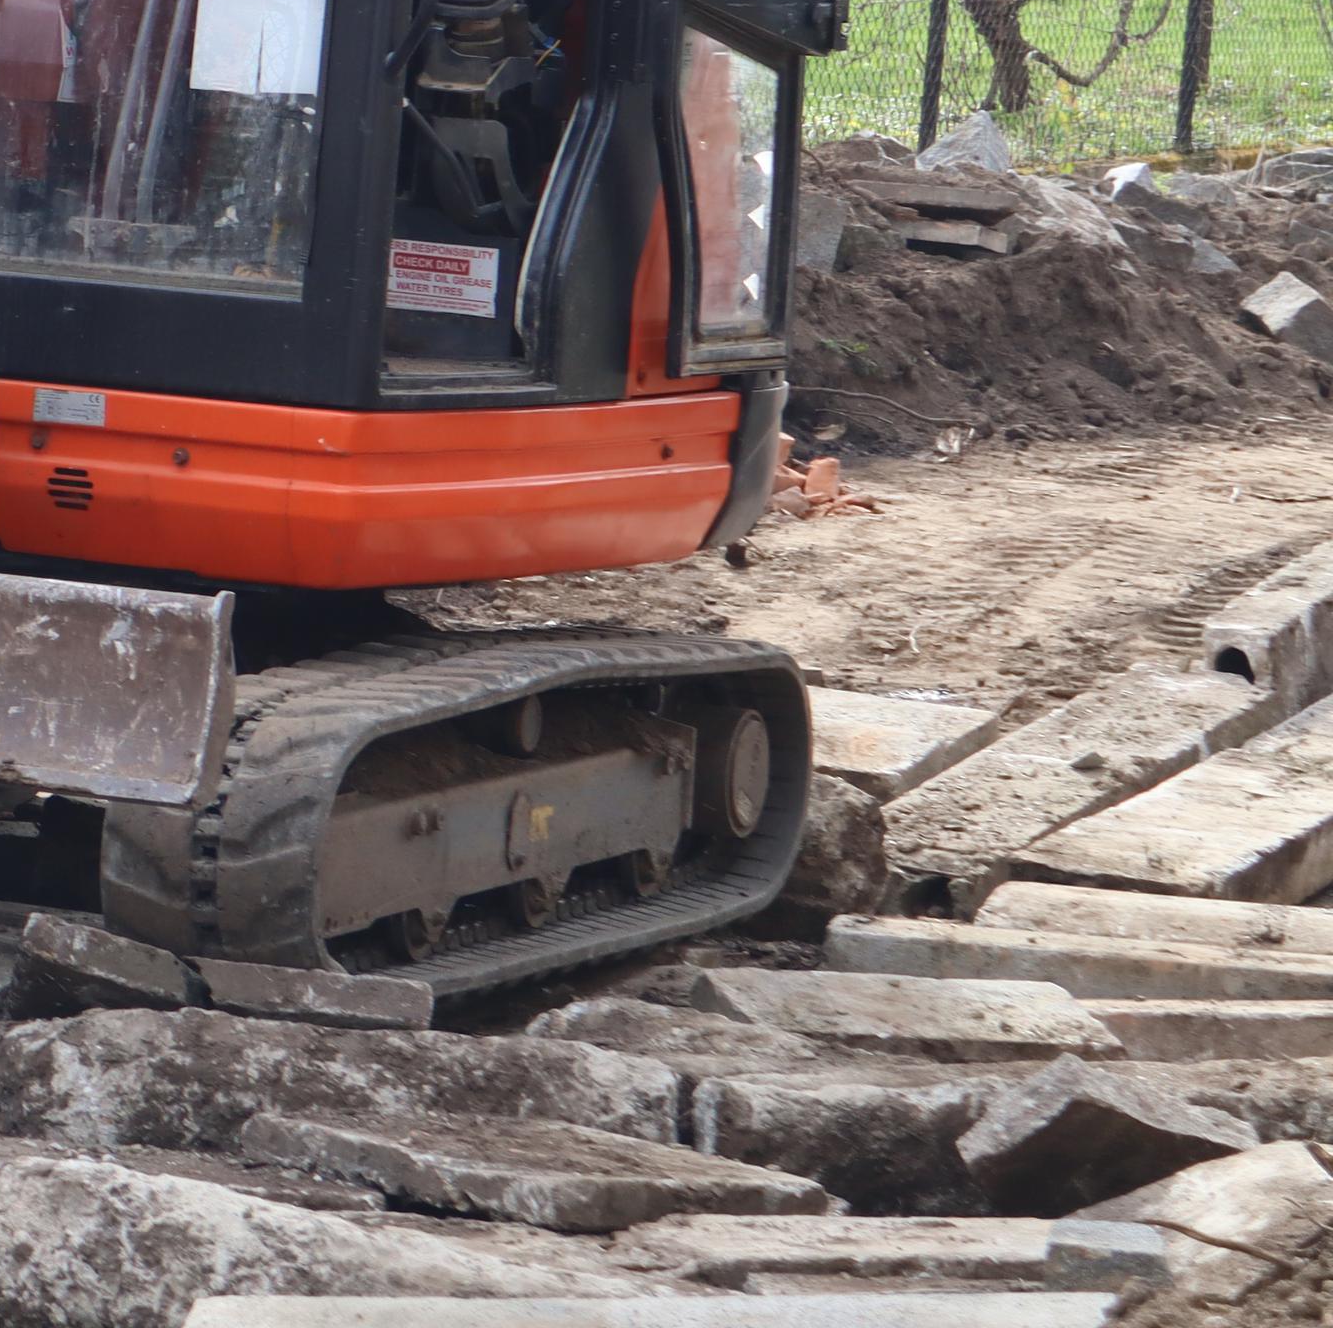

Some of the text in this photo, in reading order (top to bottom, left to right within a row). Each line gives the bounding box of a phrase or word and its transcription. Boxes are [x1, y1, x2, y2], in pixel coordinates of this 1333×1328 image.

[389, 241, 494, 260] ERS RESPONSIBILITY
[395, 255, 469, 272] CHECK DAILY
[396, 270, 432, 282] ENGINE
[435, 274, 450, 284] OIL
[452, 277, 492, 288] GREASE
[396, 282, 463, 297] WATER TYRES
